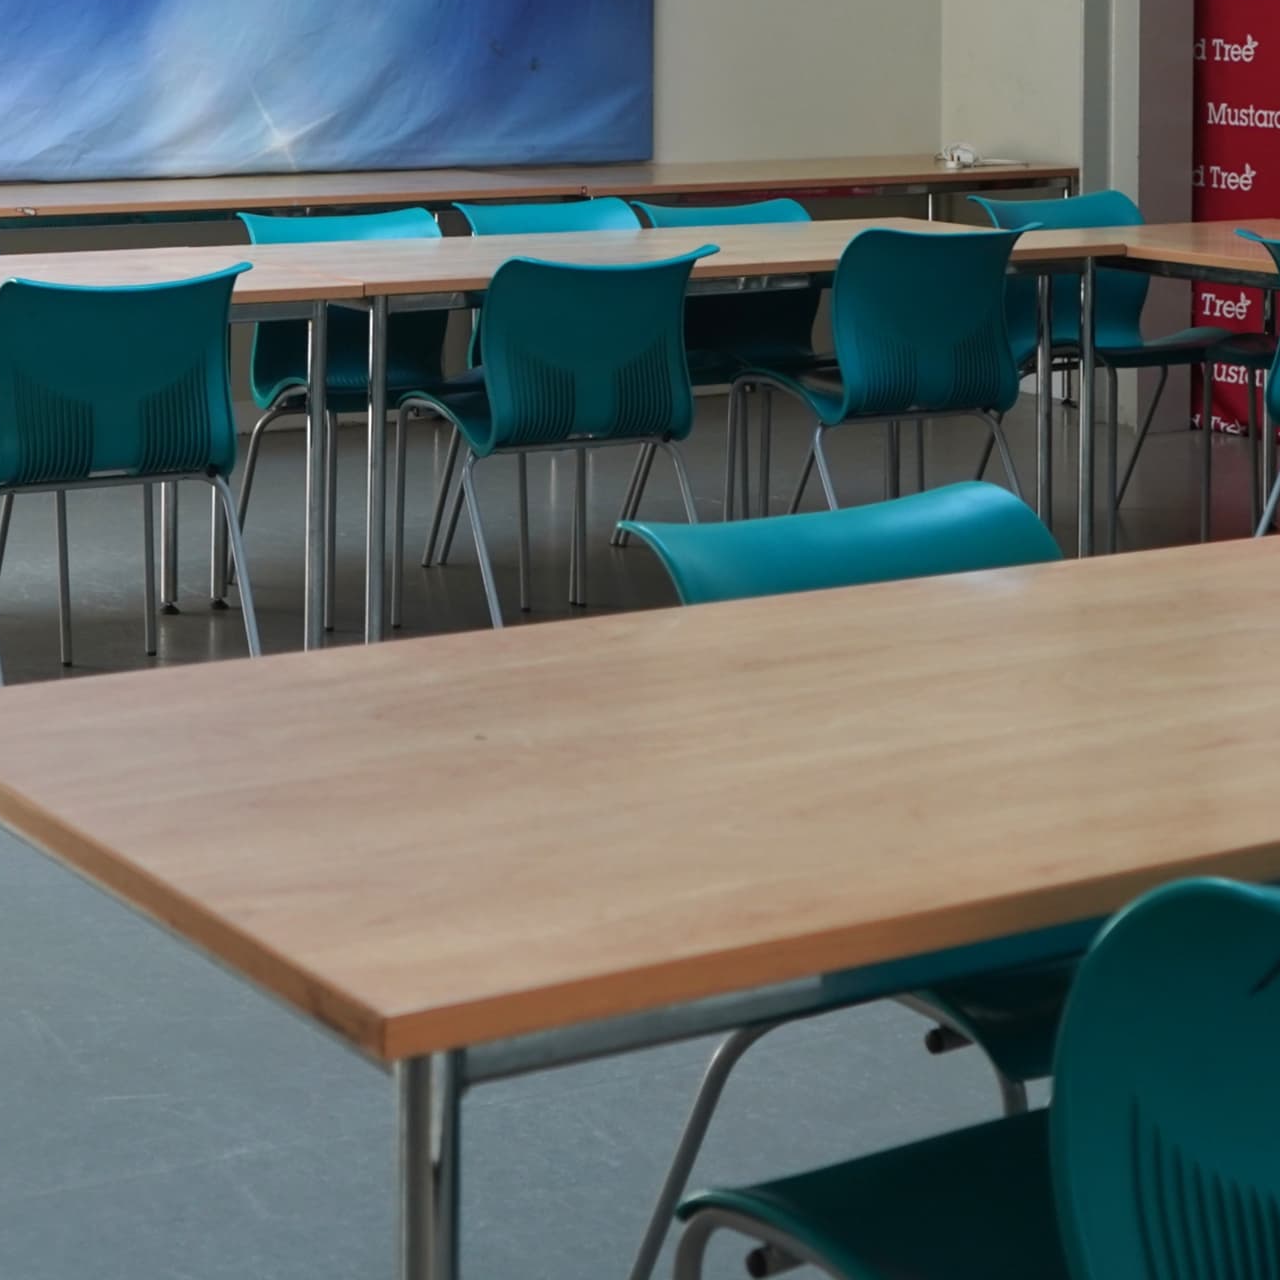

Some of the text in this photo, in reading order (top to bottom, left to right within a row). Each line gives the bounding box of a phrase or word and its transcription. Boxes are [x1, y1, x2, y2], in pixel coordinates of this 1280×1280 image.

[1212, 34, 1258, 62] Tree
[1210, 163, 1256, 191] Tree
[1202, 292, 1251, 319] Tree
